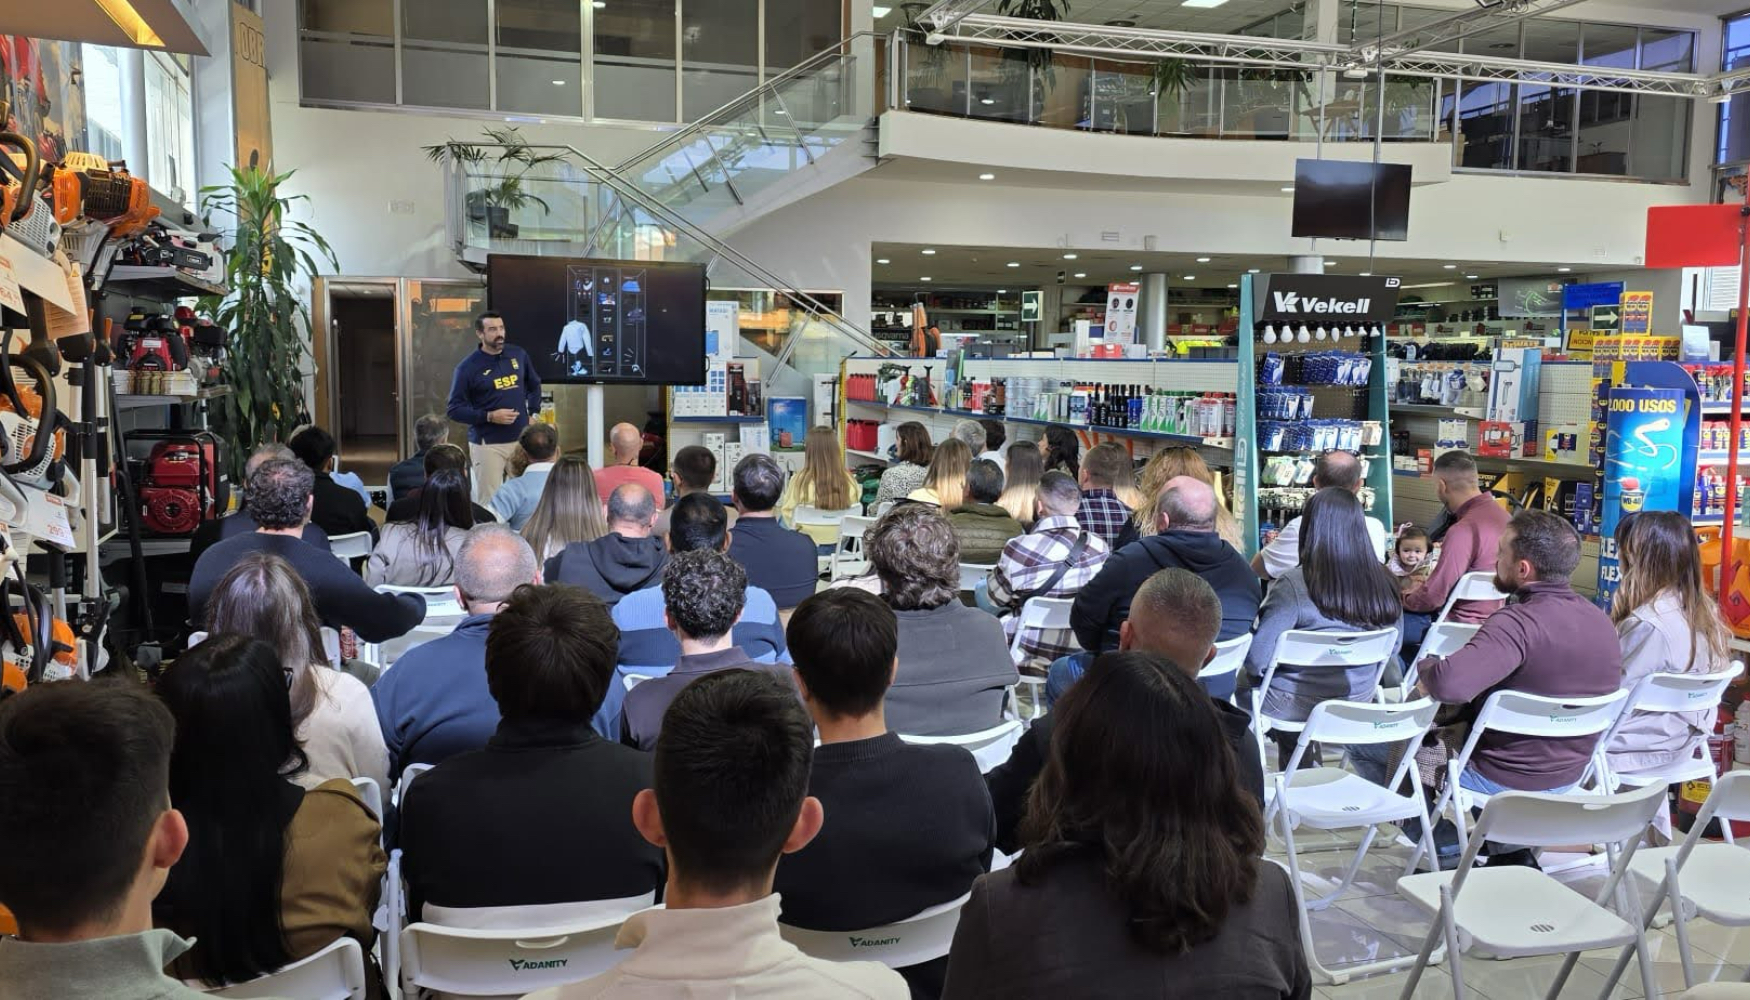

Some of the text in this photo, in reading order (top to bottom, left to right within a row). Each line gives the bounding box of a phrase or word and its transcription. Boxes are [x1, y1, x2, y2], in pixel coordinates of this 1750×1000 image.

[1301, 297, 1371, 314] Vekell
[493, 374, 518, 390] ESP
[1638, 399, 1677, 414] USOS
[860, 936, 901, 947] ADANITY
[522, 958, 568, 970] ADANITY
